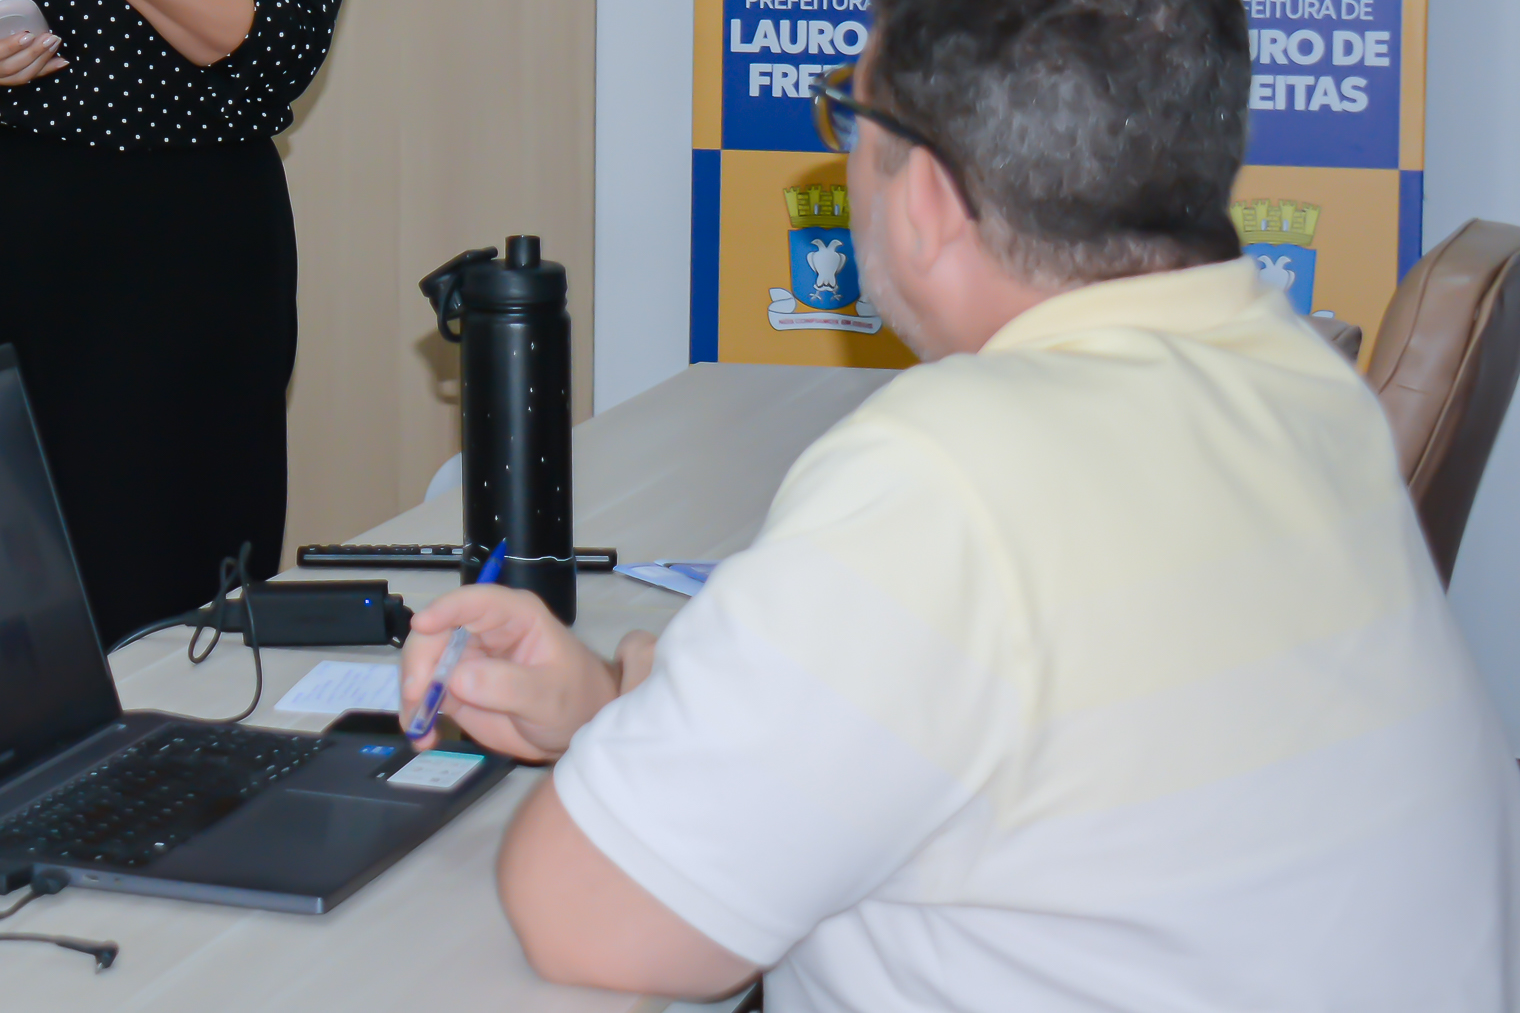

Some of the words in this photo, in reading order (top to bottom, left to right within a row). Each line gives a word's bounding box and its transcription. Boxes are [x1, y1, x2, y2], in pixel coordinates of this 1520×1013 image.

[1341, 0, 1374, 21] DE
[730, 19, 869, 56] LAURO
[1332, 31, 1391, 67] DE
[1249, 75, 1369, 113] EITAS
